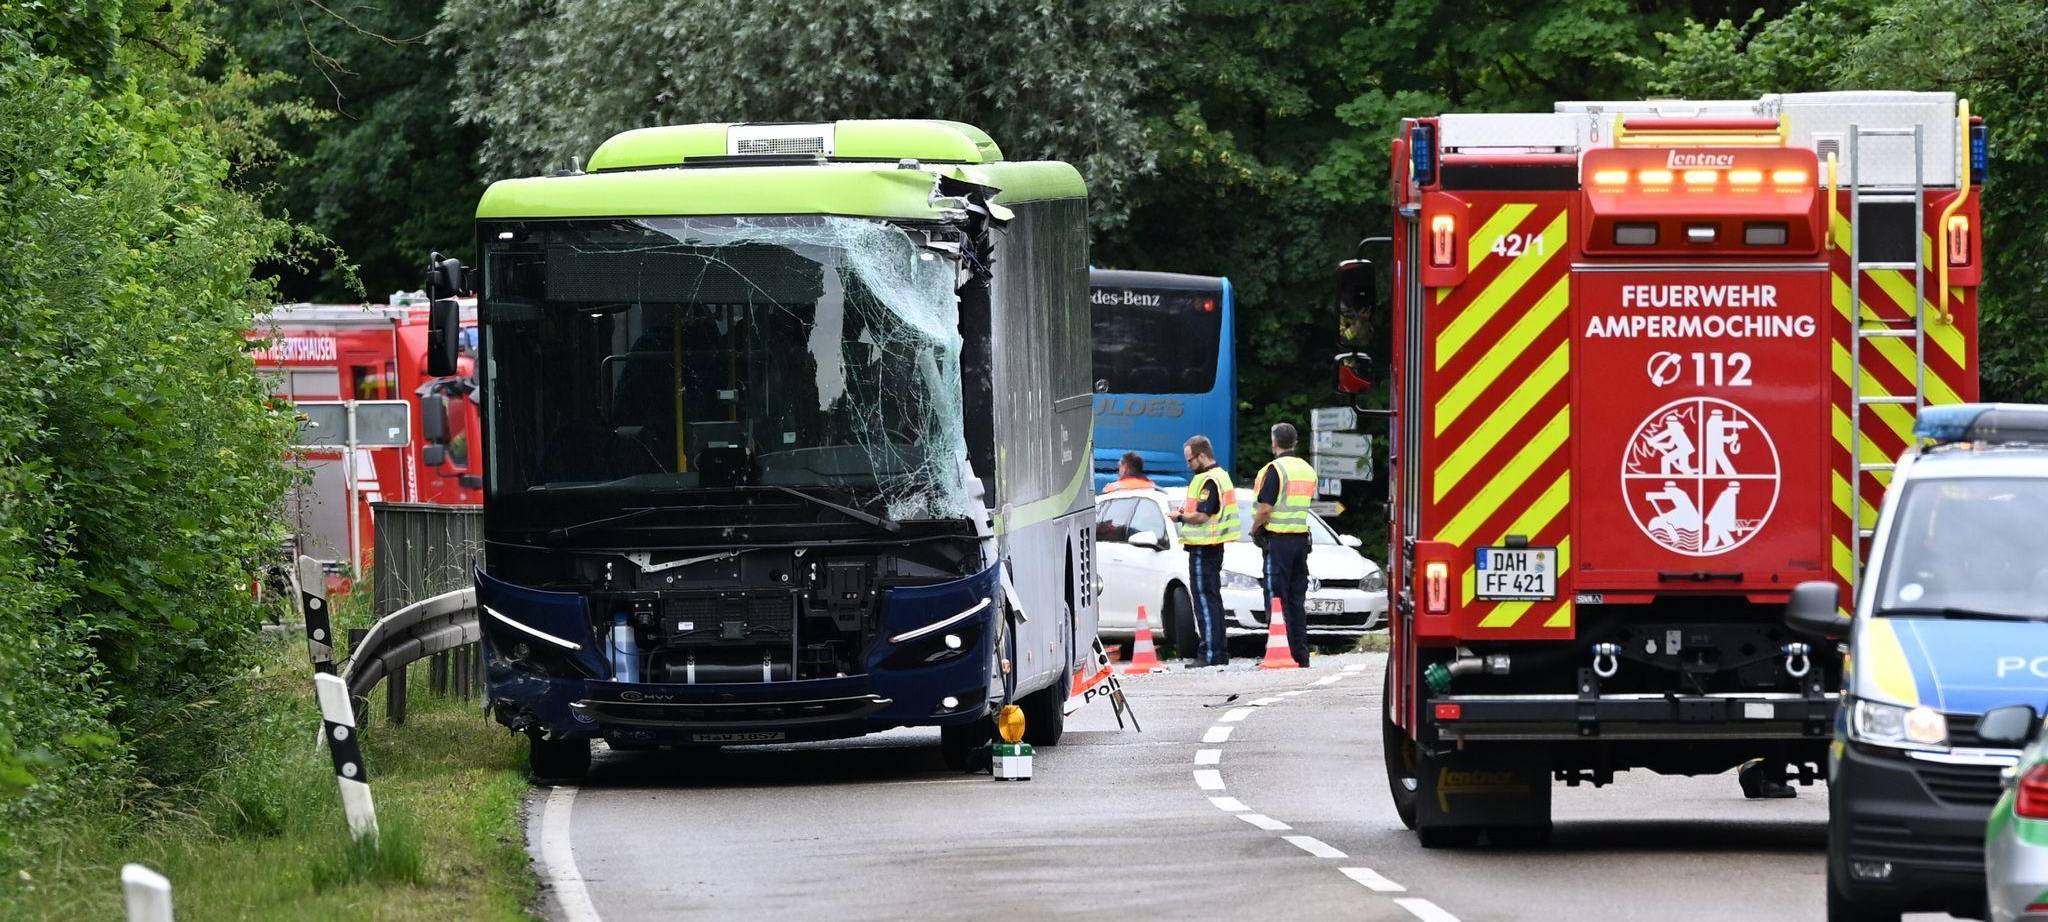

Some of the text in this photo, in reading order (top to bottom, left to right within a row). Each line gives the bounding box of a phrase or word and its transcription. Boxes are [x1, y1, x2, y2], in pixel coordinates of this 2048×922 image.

[1491, 233, 1544, 257] 42/1
[1091, 289, 1160, 307] des-Benz
[1622, 285, 1777, 307] FEUERWEHR
[1585, 315, 1816, 338] AMPERMOCHING
[1691, 352, 1752, 387] 112
[1494, 553, 1527, 571] DAH
[1486, 573, 1545, 592] FF 421
[1084, 674, 1121, 704] Poli
